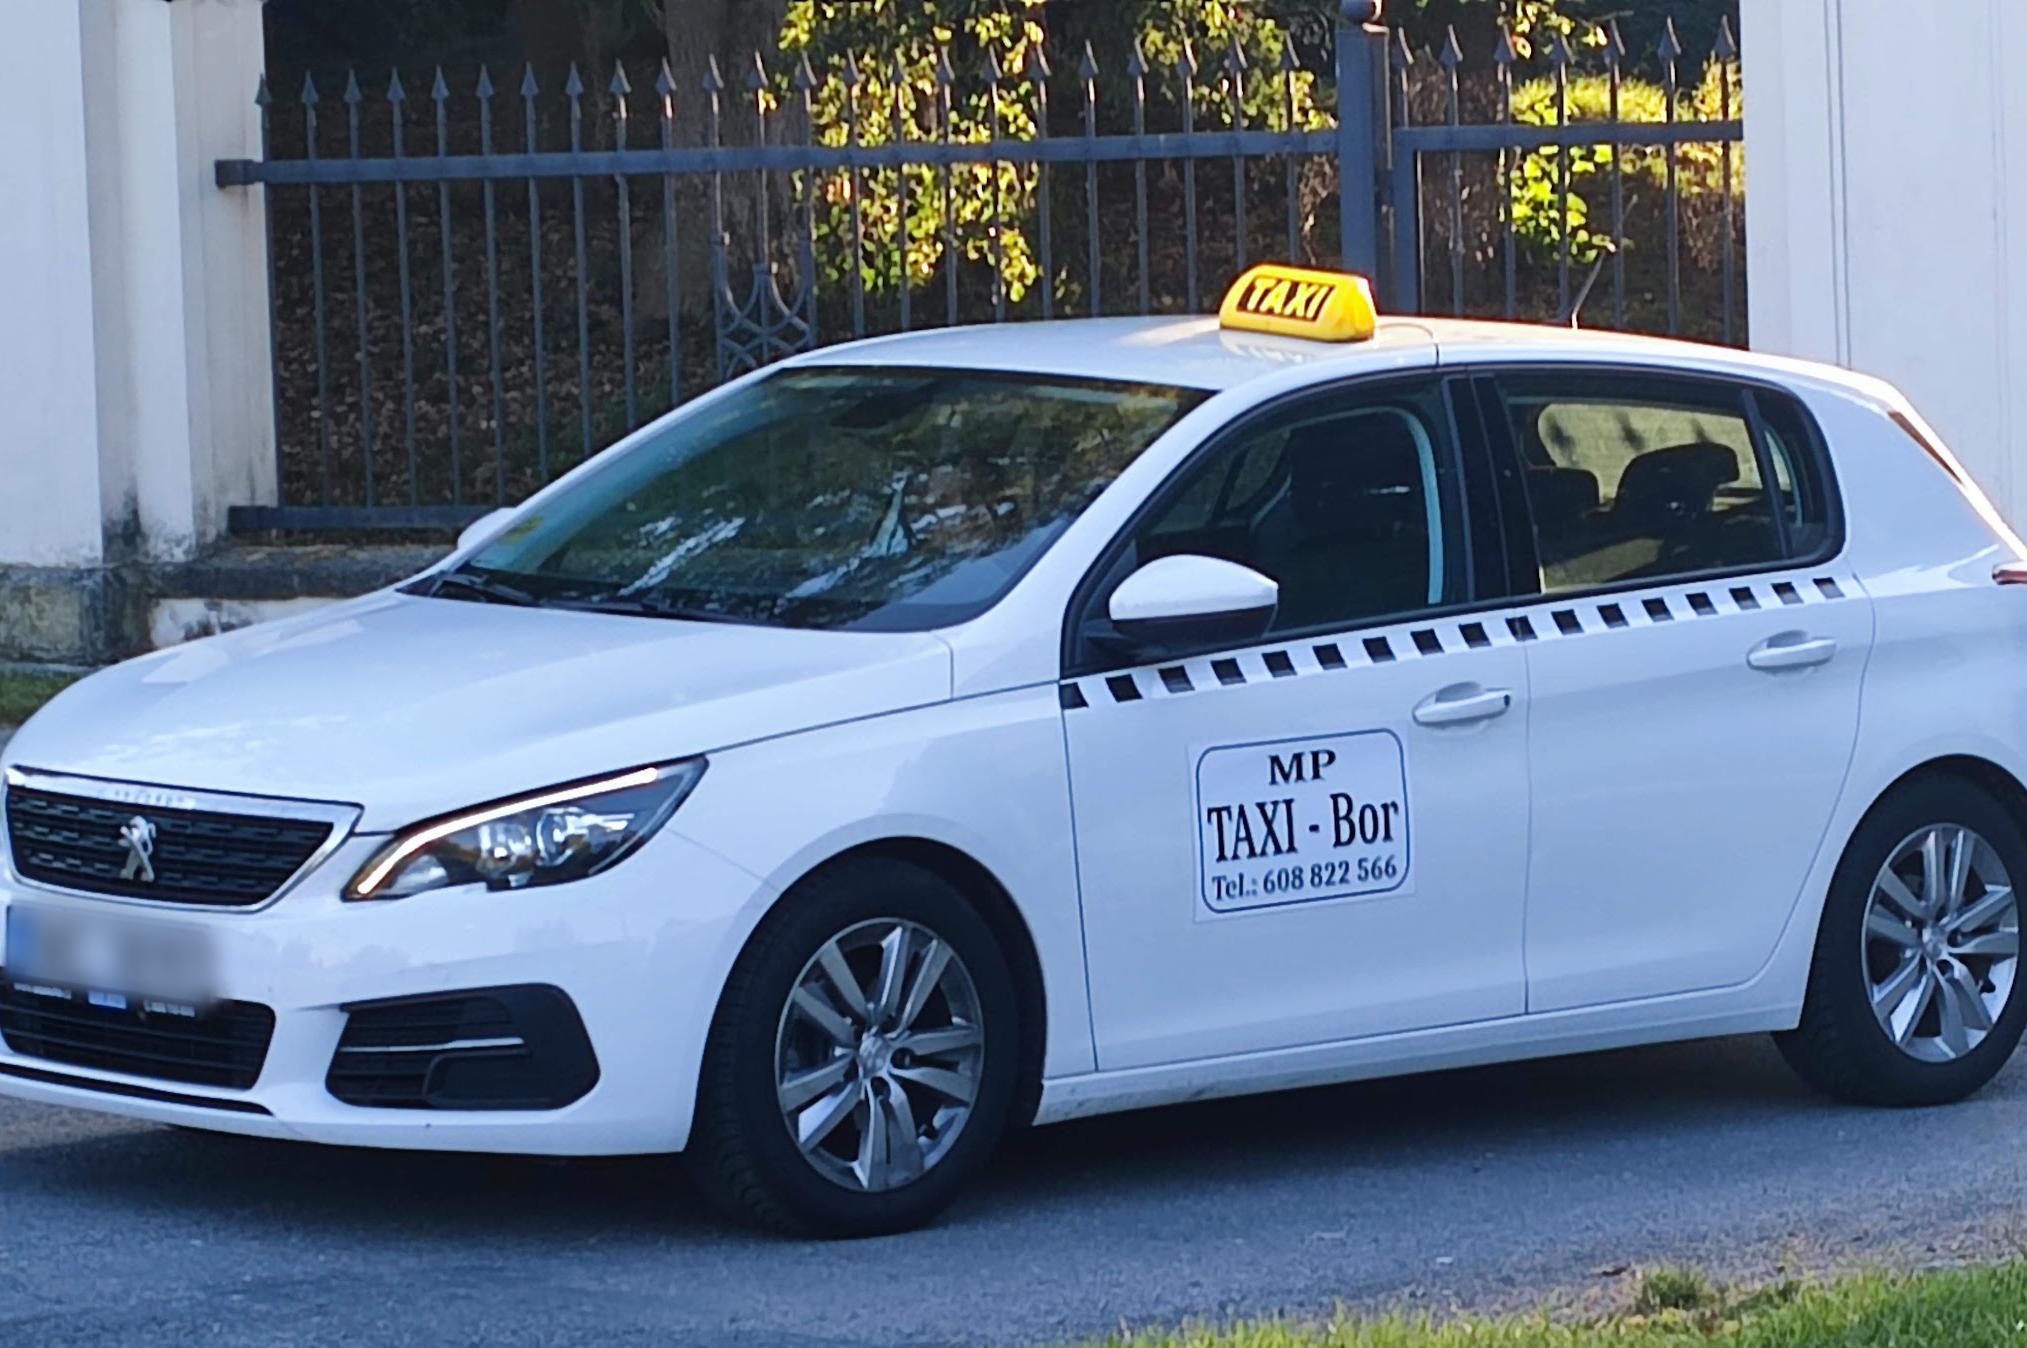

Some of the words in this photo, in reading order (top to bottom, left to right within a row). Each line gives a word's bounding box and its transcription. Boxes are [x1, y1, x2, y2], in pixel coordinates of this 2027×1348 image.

[1247, 278, 1330, 319] TAXI
[1269, 749, 1336, 785] MP
[1207, 798, 1298, 863] TAXI
[1329, 792, 1398, 848] Bor
[1212, 872, 1258, 901] Tel.:
[1263, 866, 1304, 894] 608
[1310, 860, 1350, 888] 822
[1357, 854, 1397, 882] 566
